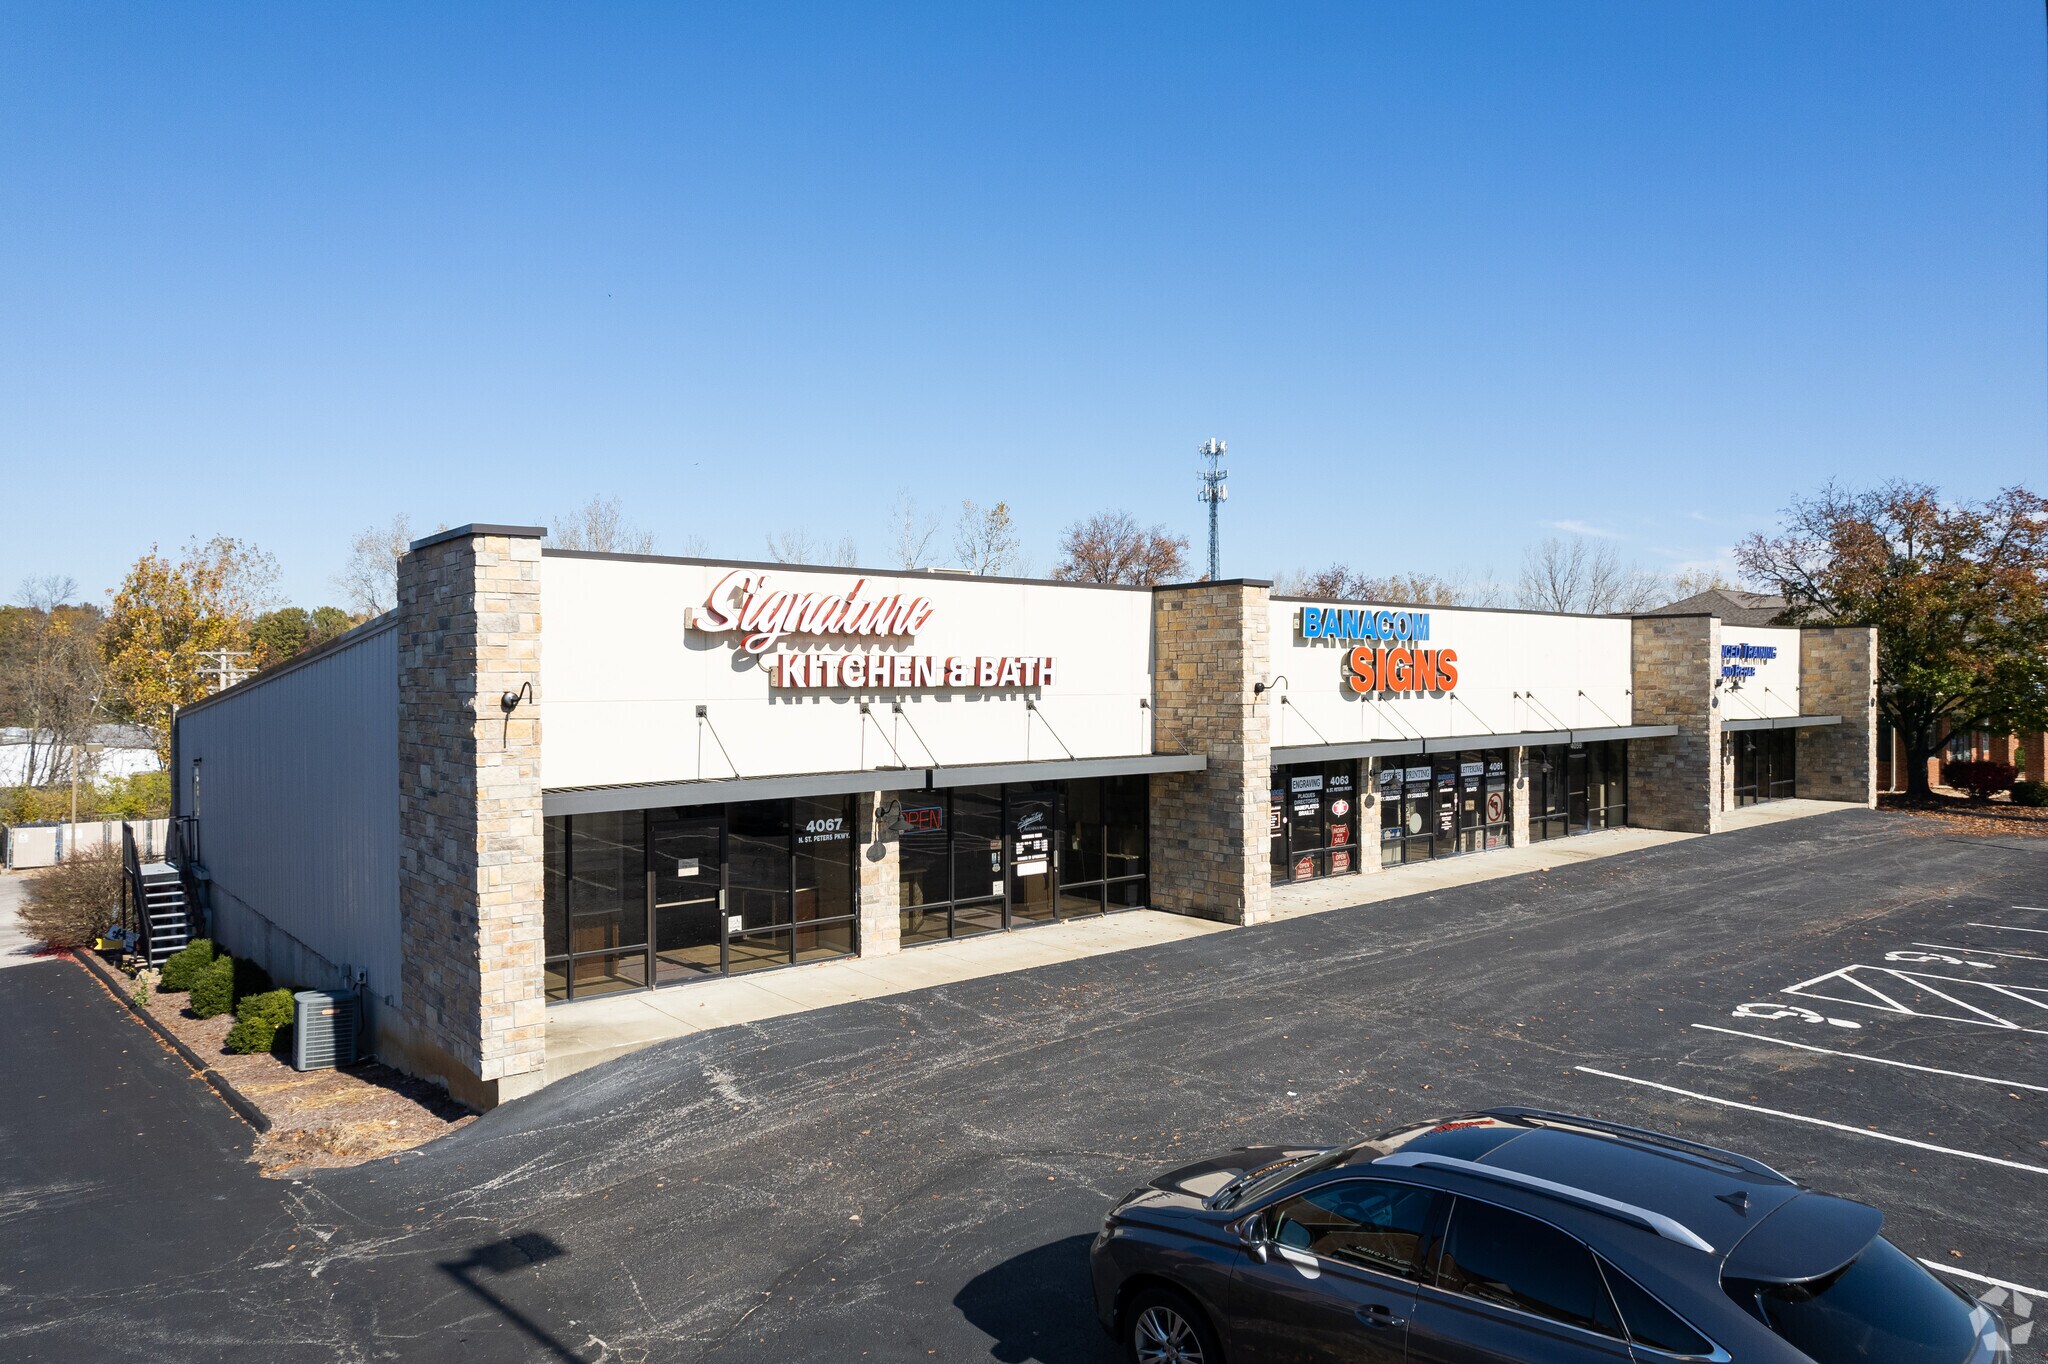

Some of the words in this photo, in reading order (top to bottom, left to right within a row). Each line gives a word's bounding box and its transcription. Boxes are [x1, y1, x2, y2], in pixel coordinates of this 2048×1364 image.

[693, 570, 933, 653] Signature
[1300, 607, 1430, 641] BANACOM
[778, 654, 936, 688] KITCHEN
[945, 656, 967, 687] &
[976, 656, 1057, 687] BATH
[1348, 646, 1458, 693] SIGNS
[1330, 776, 1349, 785] 4063
[1406, 769, 1430, 780] PRINTING
[1292, 779, 1321, 790] ENGRAVING
[806, 818, 843, 833] 4067
[813, 834, 833, 842] PETERS
